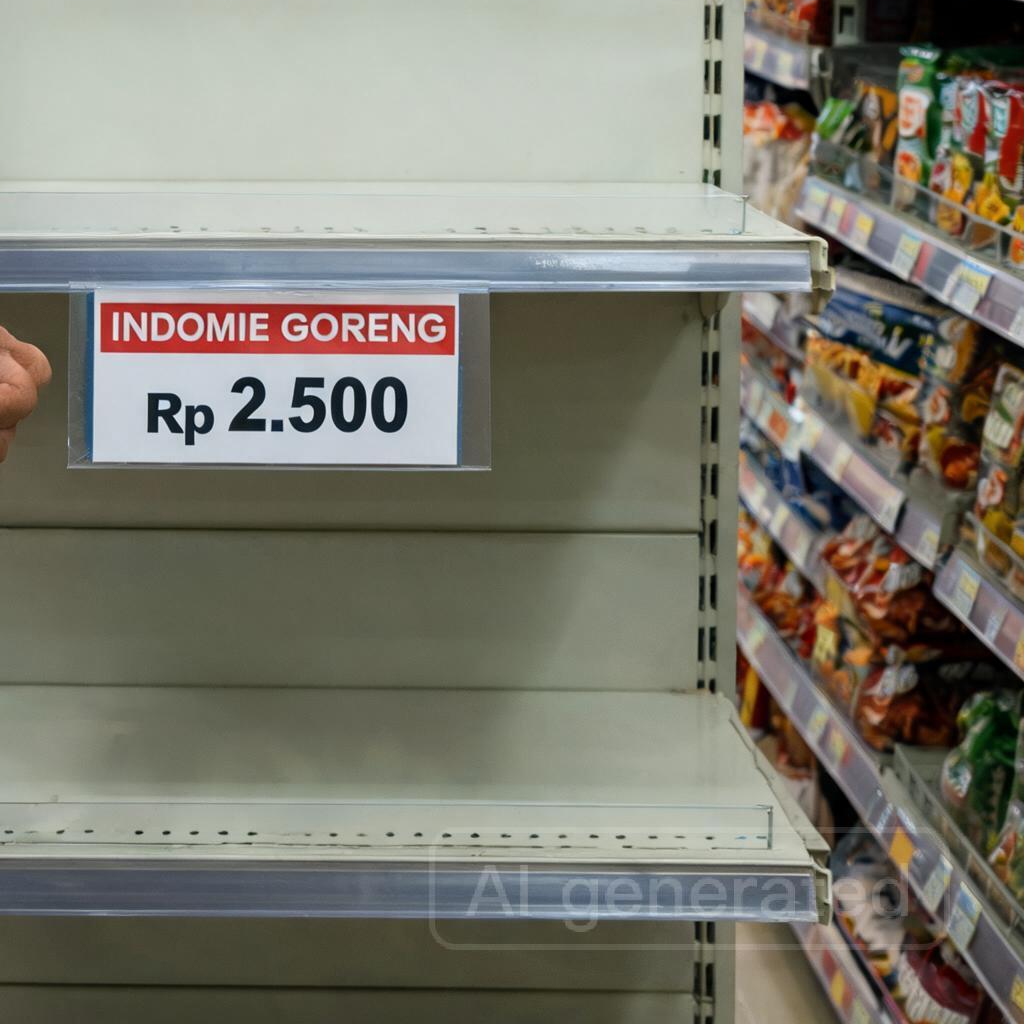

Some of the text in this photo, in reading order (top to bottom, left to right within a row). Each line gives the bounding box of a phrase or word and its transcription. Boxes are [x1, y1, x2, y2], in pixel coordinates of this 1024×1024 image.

[111, 311, 447, 344] INDOMIE GORENG
[146, 376, 408, 446] Rp 2.500
